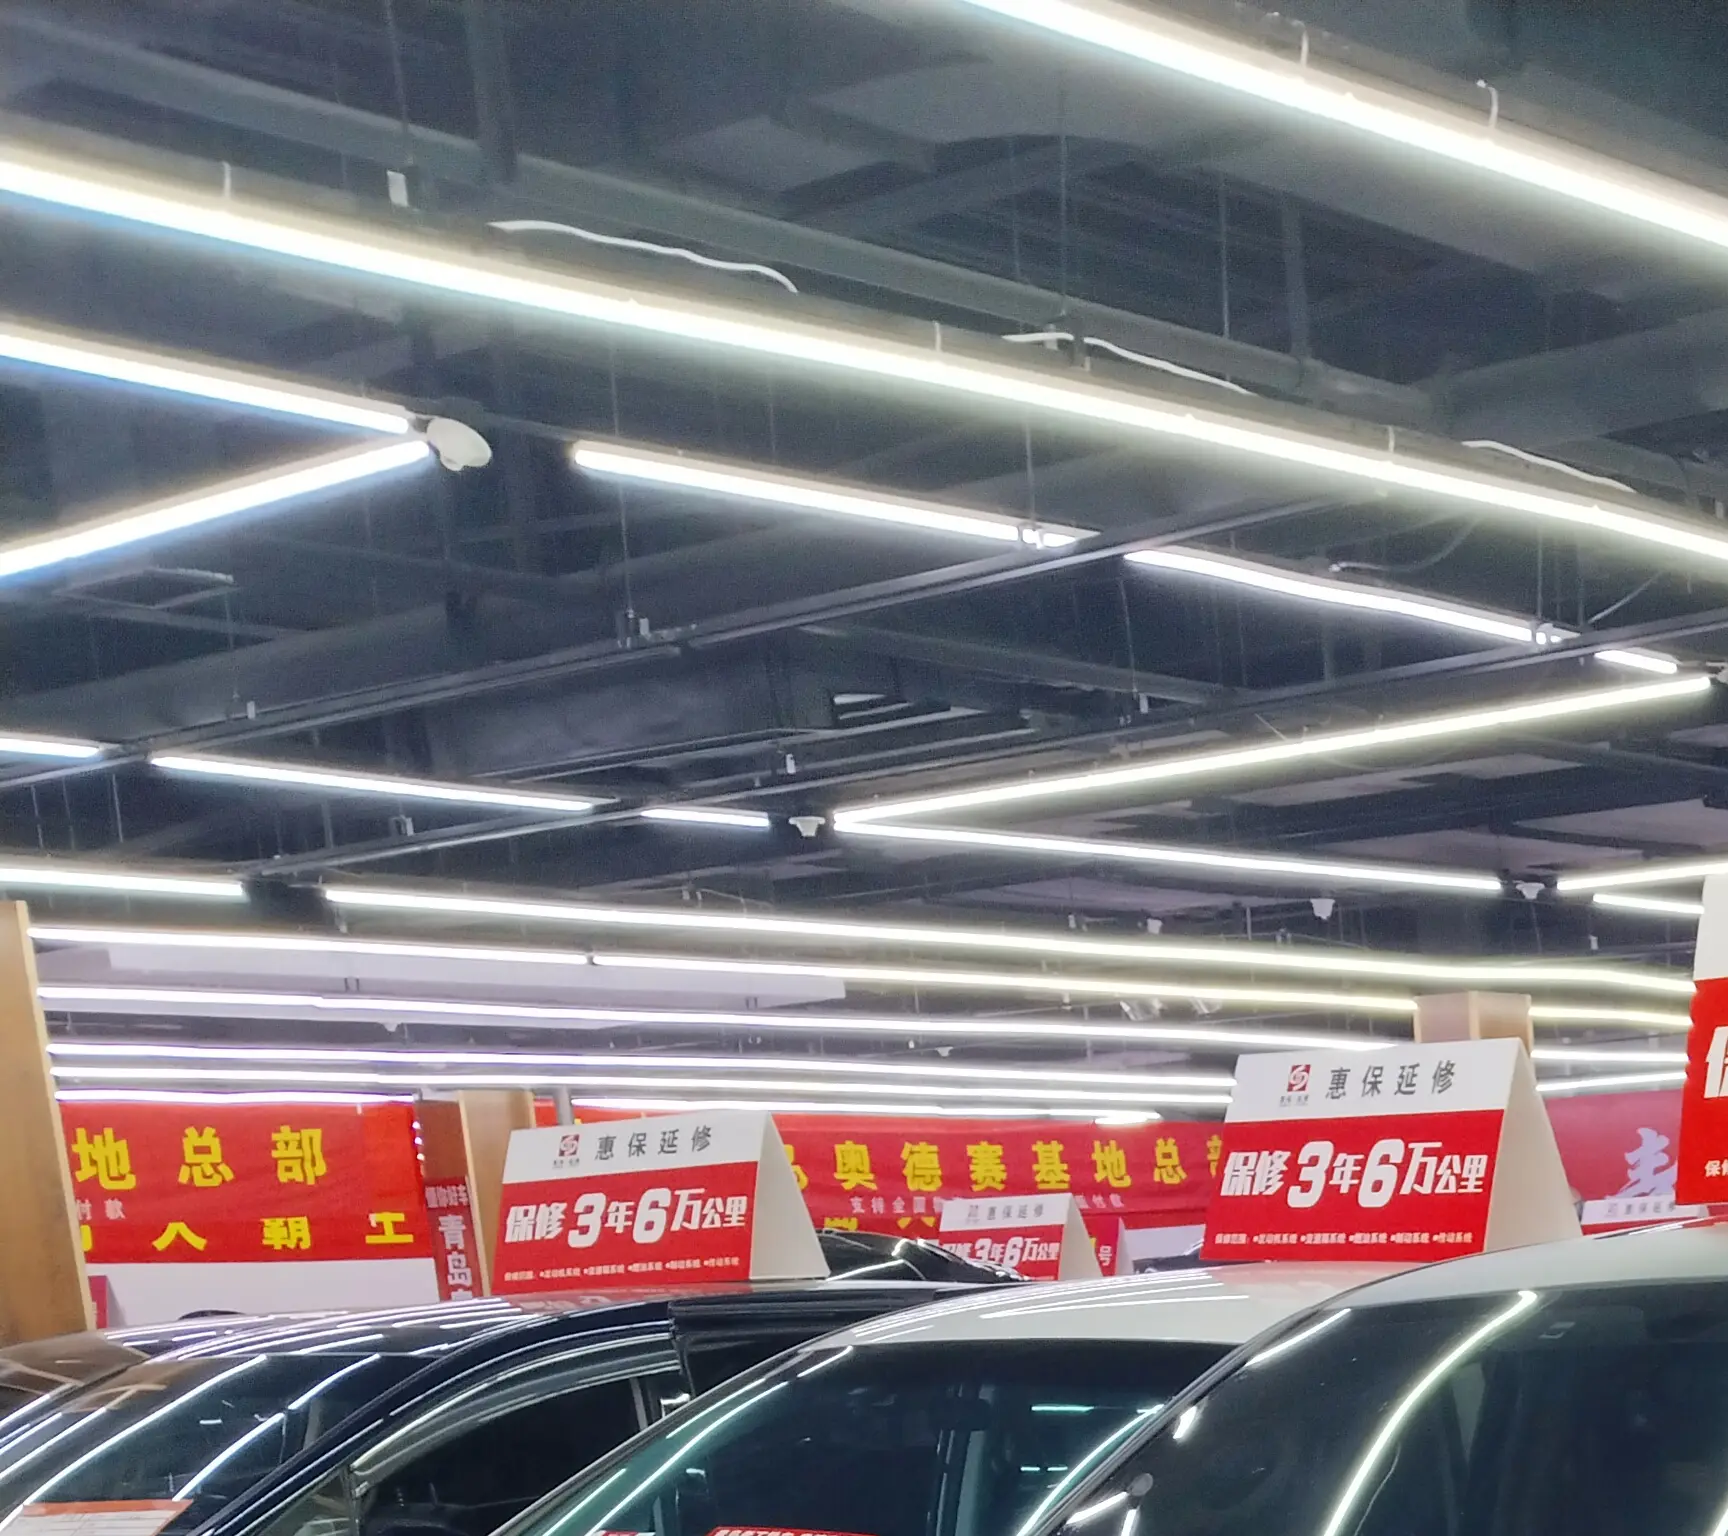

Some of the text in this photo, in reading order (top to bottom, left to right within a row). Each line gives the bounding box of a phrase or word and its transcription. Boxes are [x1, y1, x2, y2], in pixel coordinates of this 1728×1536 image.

[1326, 1060, 1456, 1100] 惠保延修
[72, 1125, 328, 1191] 地总部
[595, 1124, 713, 1161] 惠保延修
[1220, 1139, 1488, 1208] 保修3年6万公里
[504, 1187, 748, 1249] 保修3年6万公里
